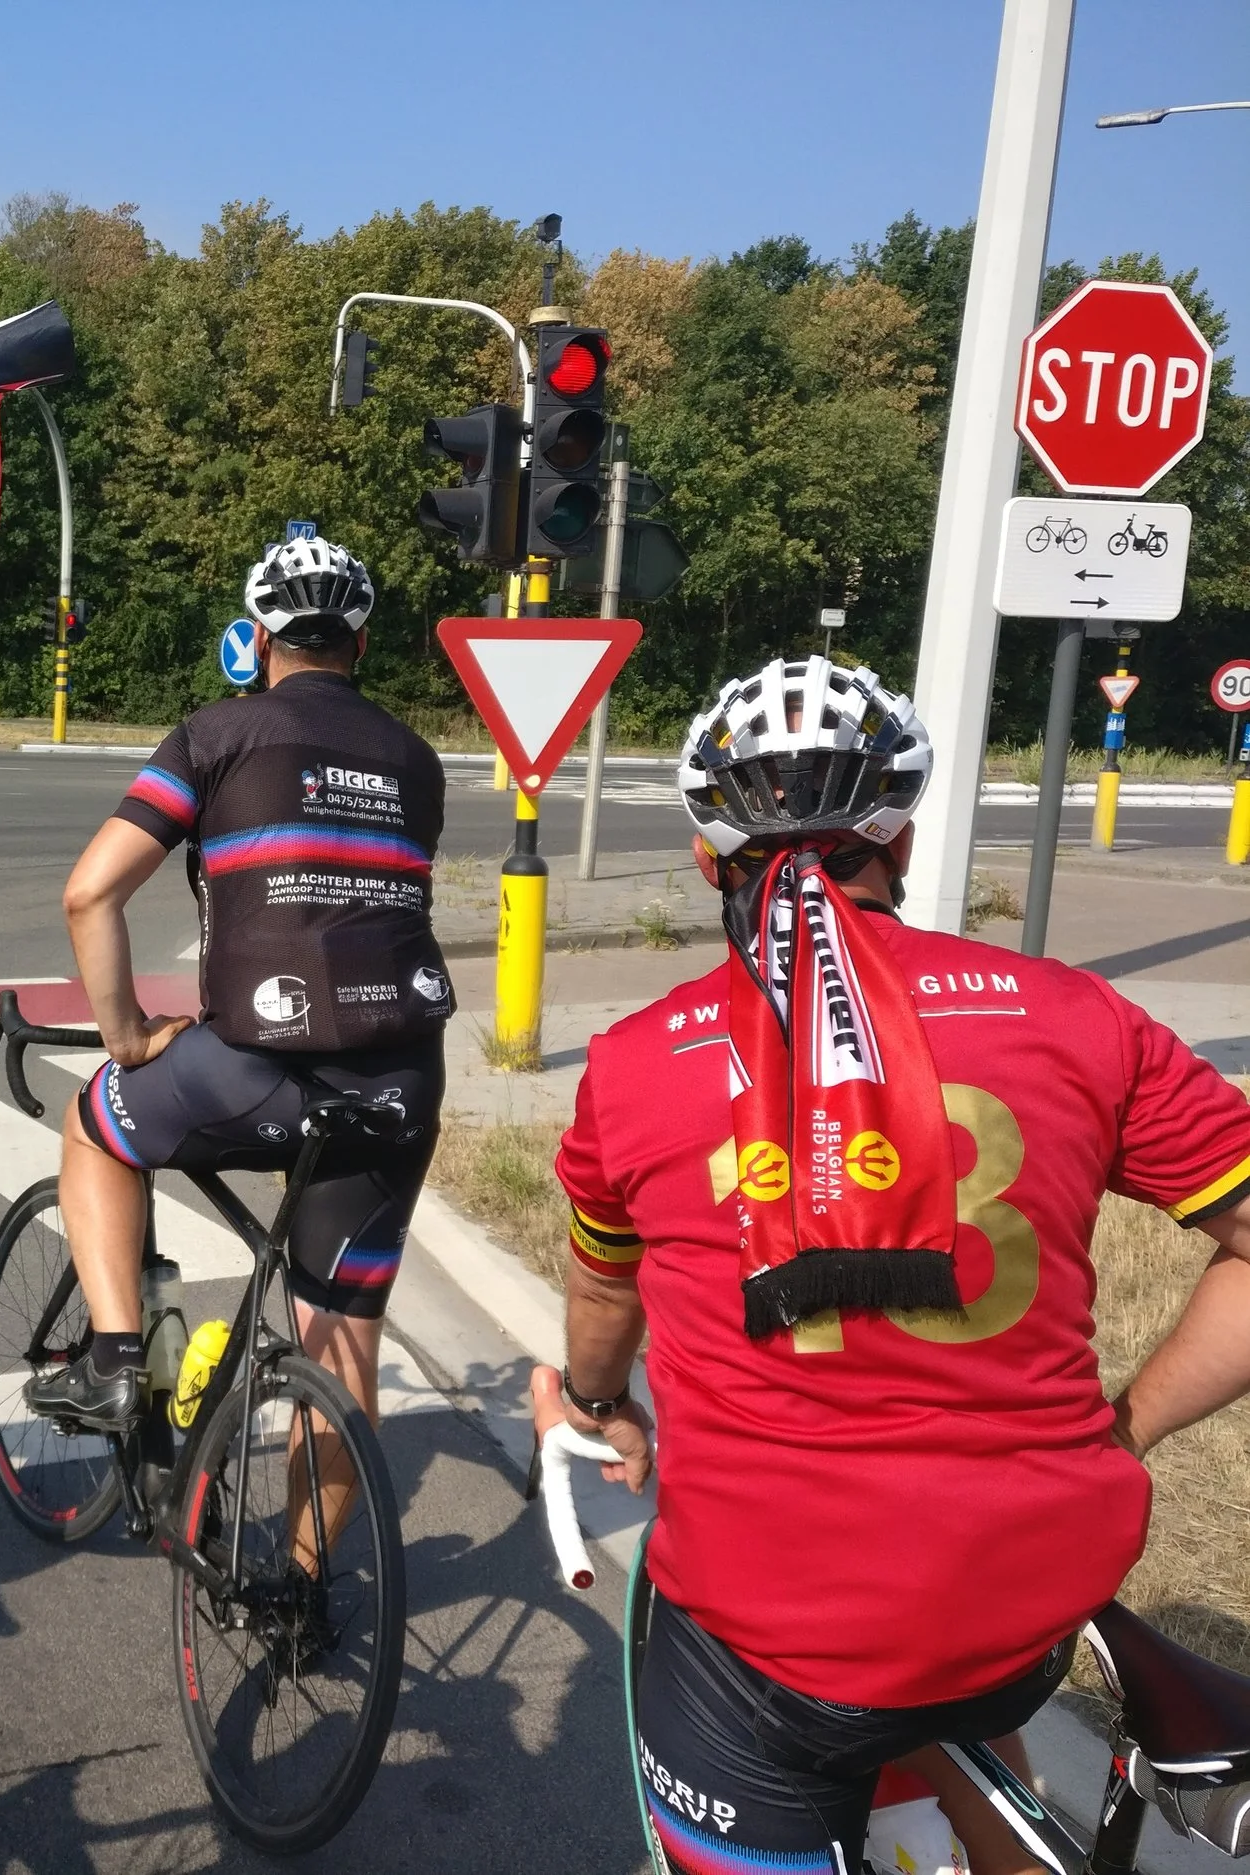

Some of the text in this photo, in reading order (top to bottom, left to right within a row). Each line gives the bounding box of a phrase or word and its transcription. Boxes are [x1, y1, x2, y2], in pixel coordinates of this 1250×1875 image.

[1033, 347, 1199, 430] STOP
[1222, 676, 1250, 697] 90
[385, 815, 392, 823] &
[267, 874, 295, 887] VAN
[299, 873, 352, 887] ACHTER
[356, 878, 386, 890] DIRK
[390, 881, 398, 892] &
[267, 886, 313, 897] AANKOOP
[330, 888, 371, 898] OPHALEN
[373, 891, 396, 900] OUDE
[267, 895, 350, 905] CONTAINERDIENST
[359, 984, 398, 994] INGRID
[915, 972, 1020, 995] GIUM
[361, 993, 370, 1002] &
[371, 992, 398, 1001] DAVY
[812, 1109, 827, 1216] RED DEVILS
[828, 1121, 843, 1201] BELGIAN
[639, 1735, 736, 1819] INGRID
[653, 1773, 736, 1834] DAVY
